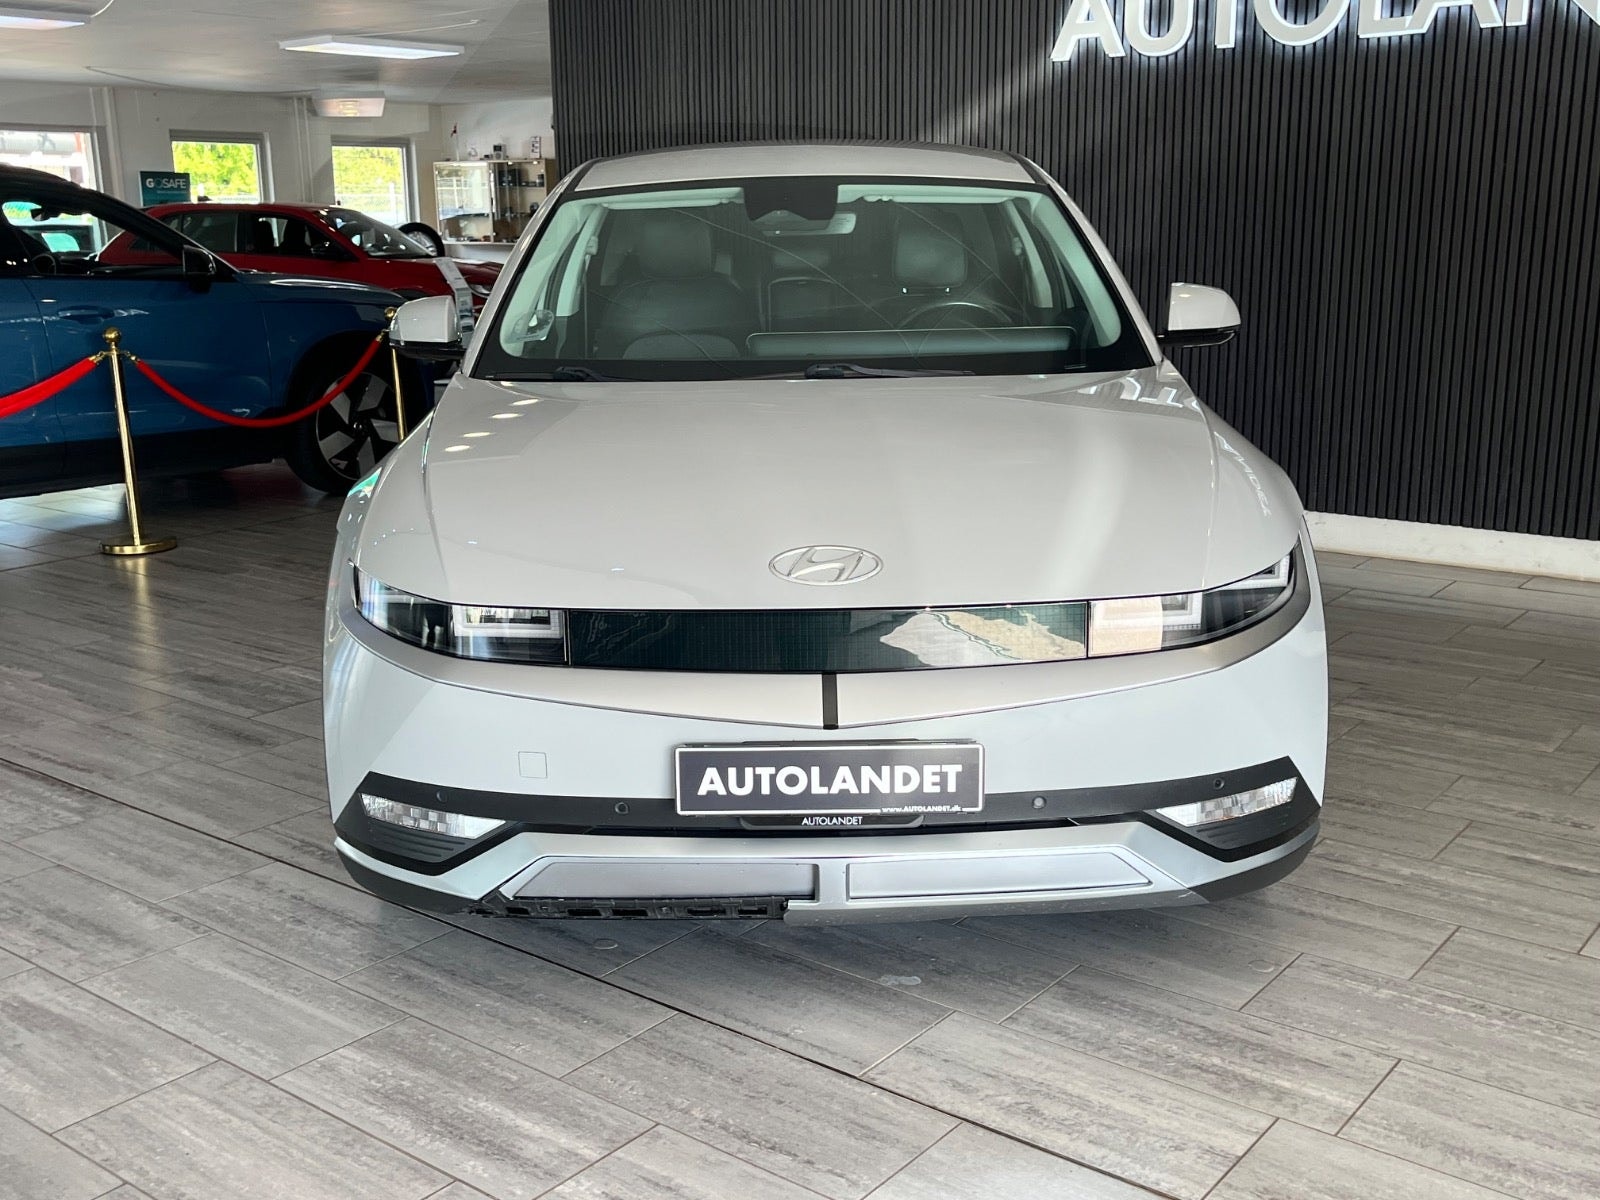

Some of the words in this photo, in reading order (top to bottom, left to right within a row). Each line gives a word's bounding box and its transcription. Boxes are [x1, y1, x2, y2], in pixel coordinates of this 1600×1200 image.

[697, 764, 963, 796] AUTOLANDET
[881, 804, 962, 813] www.AUTOLANDET.dk
[801, 816, 863, 826] AUTOLANDET
